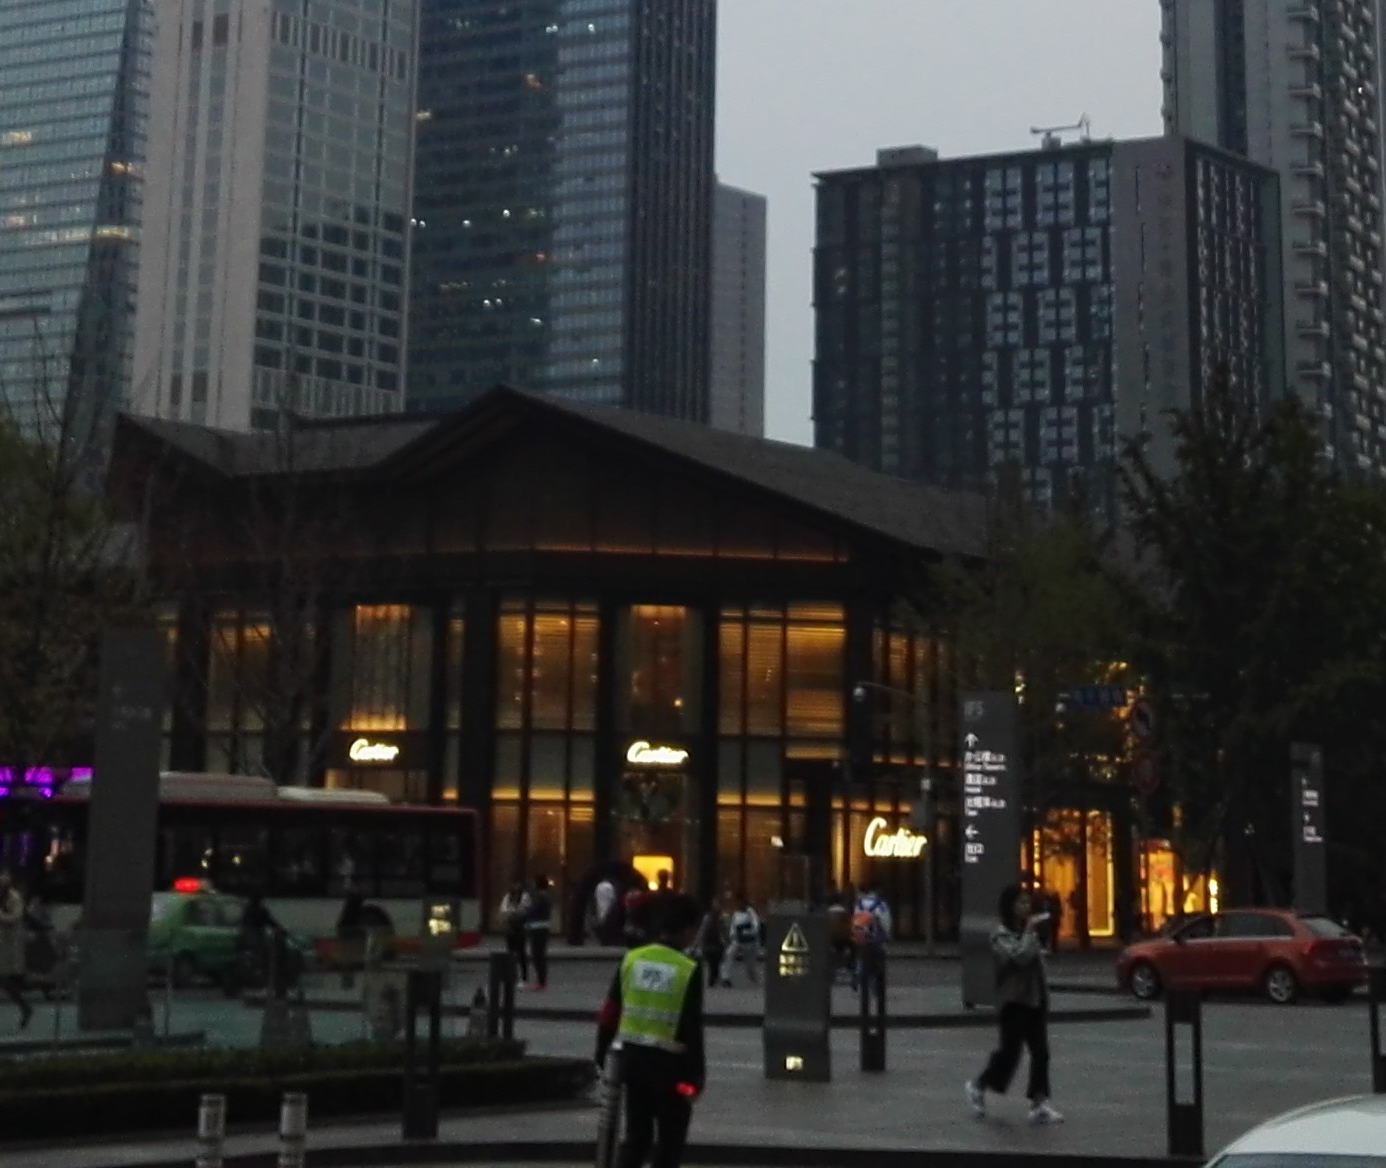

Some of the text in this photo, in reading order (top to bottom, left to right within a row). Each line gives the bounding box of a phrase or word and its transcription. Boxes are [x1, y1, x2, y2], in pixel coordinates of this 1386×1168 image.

[349, 738, 399, 761] Cartier
[627, 741, 688, 763] Cartier
[864, 817, 927, 857] Cartier
